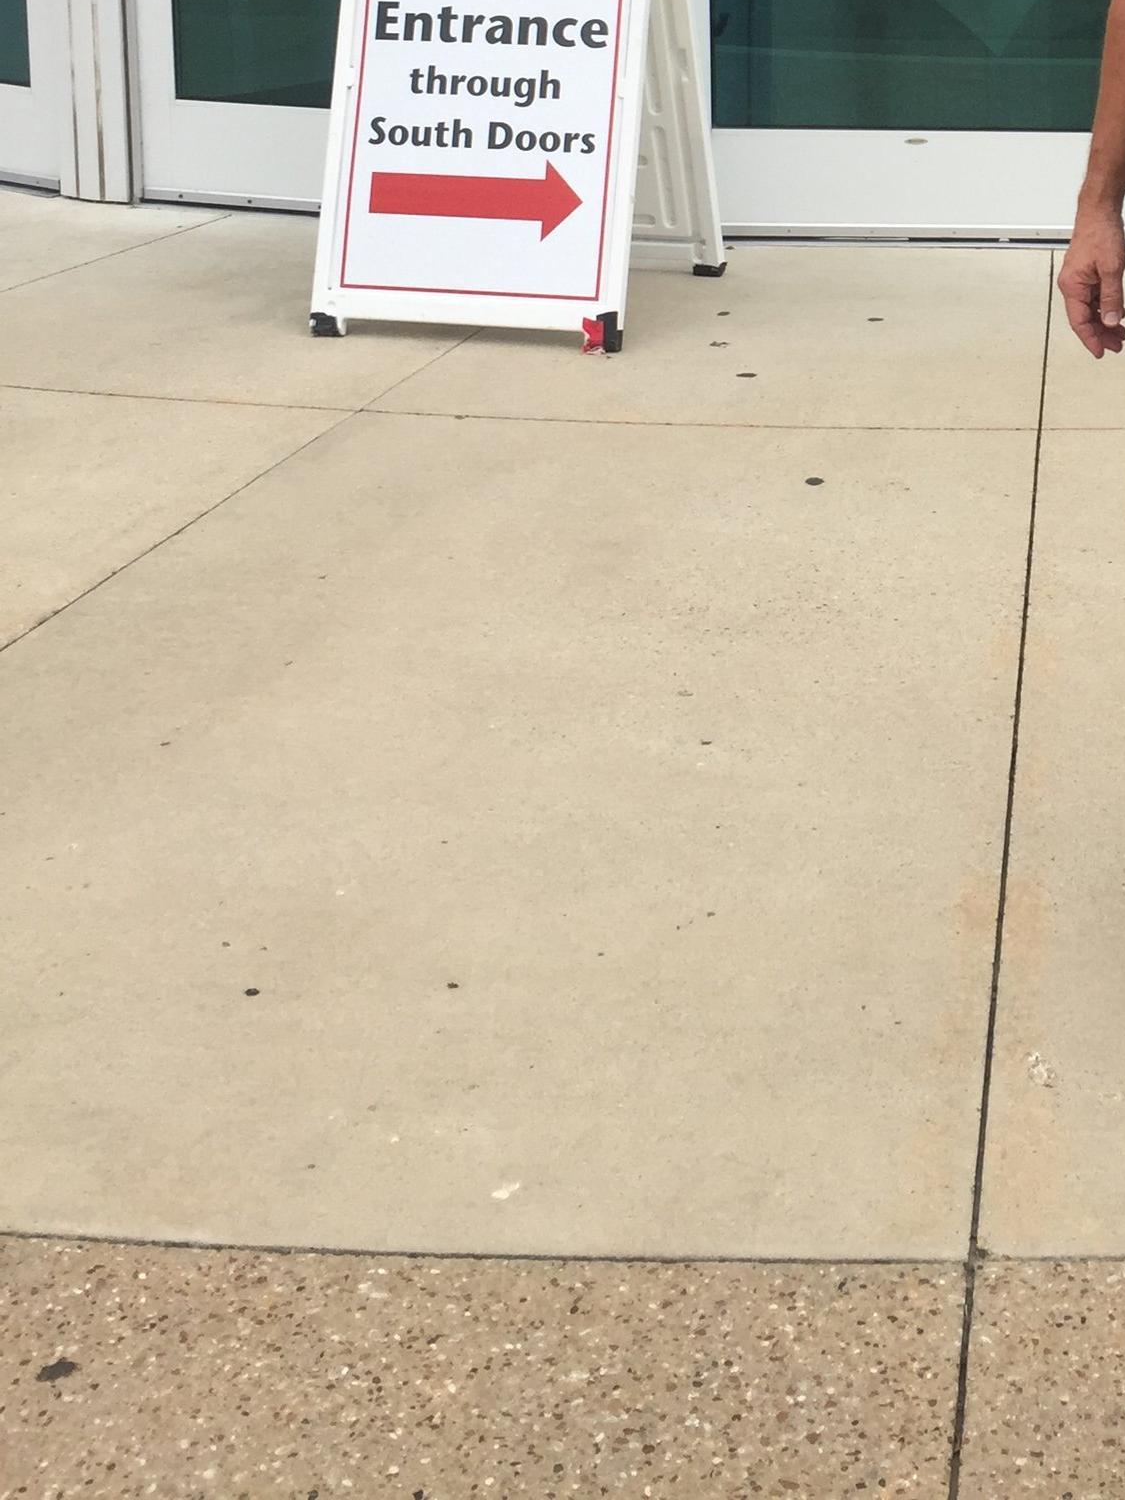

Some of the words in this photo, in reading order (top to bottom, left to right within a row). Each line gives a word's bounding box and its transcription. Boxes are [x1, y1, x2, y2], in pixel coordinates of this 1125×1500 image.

[375, 0, 610, 50] Entrance
[409, 64, 561, 108] through
[368, 116, 473, 149] South
[487, 121, 597, 155] Doors
